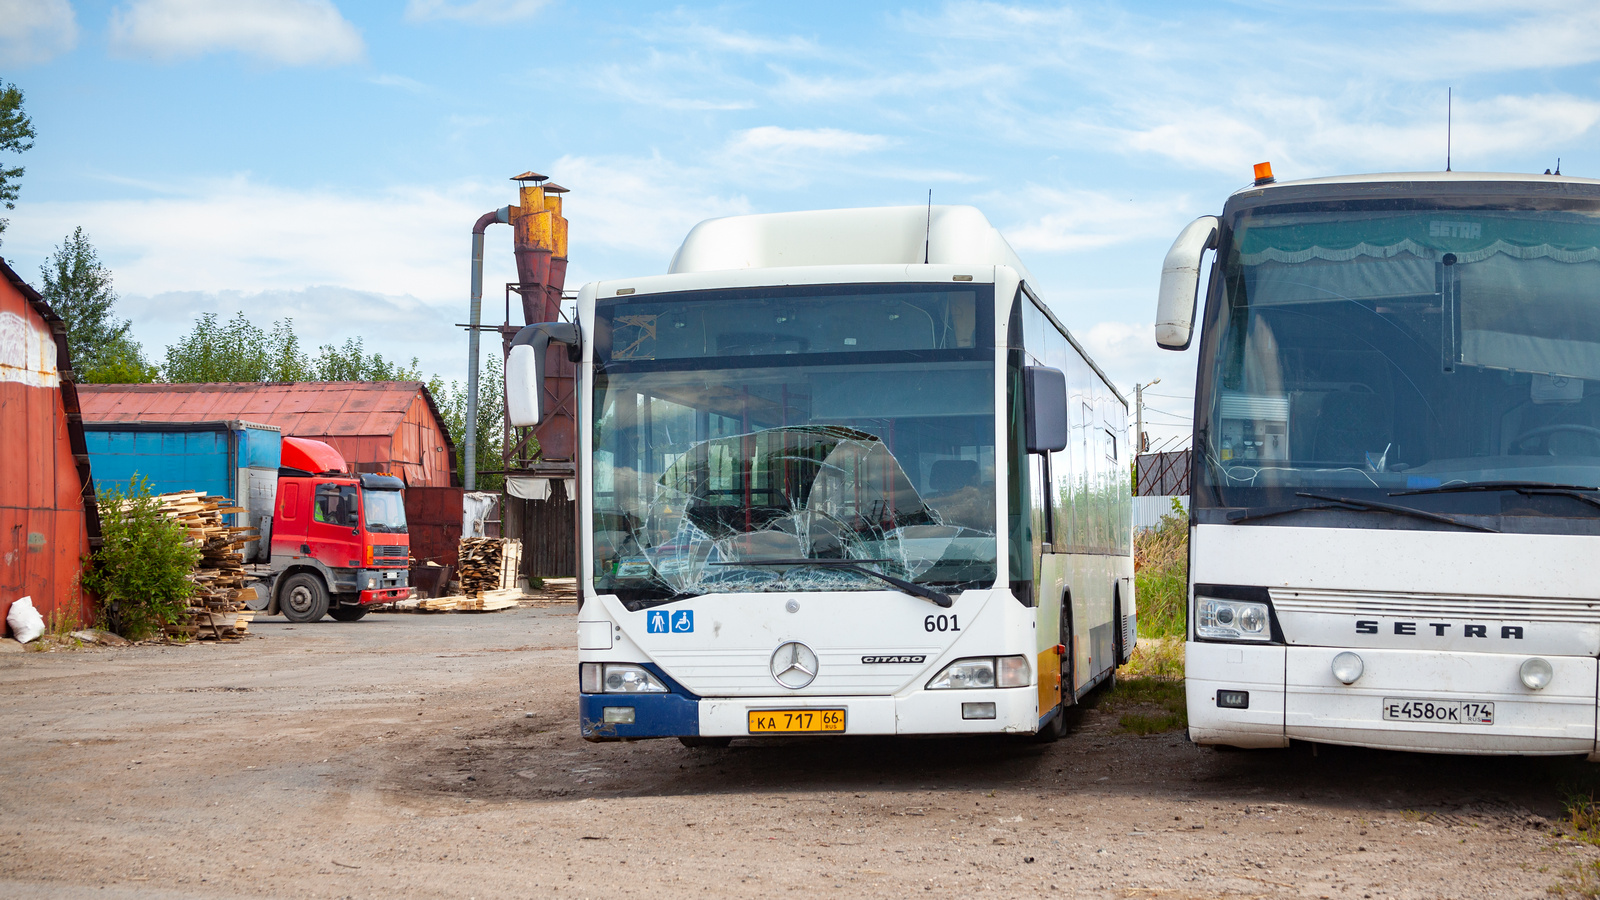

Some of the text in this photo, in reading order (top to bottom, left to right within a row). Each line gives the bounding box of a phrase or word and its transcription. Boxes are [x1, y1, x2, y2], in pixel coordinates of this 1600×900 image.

[1429, 220, 1482, 239] SETRA
[924, 614, 961, 632] 601
[1356, 620, 1524, 640] SETRA
[1463, 704, 1490, 718] 174
[784, 713, 814, 729] 717
[823, 712, 839, 724] 66
